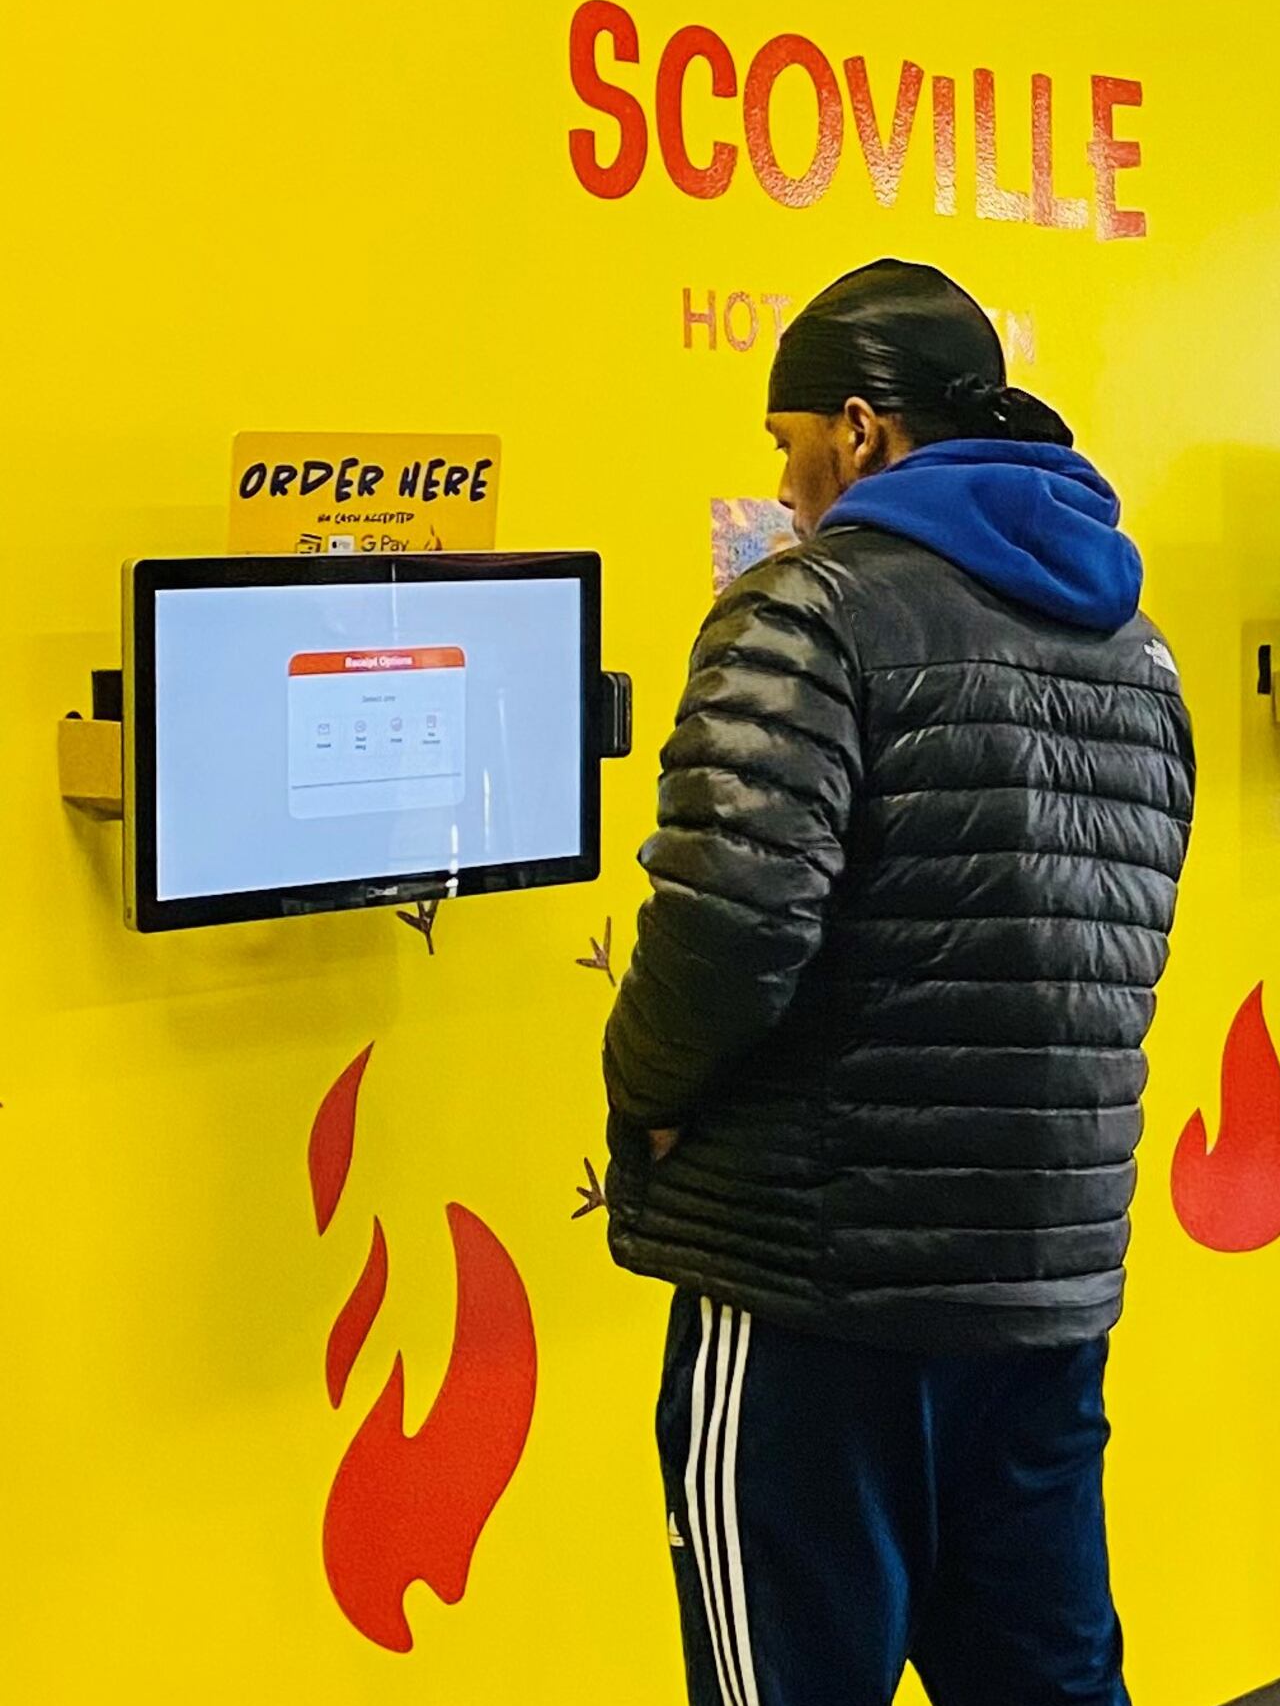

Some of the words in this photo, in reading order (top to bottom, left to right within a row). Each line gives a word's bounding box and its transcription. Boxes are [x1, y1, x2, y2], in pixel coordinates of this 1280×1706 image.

[682, 287, 794, 352] HOT
[239, 457, 384, 503] ORDER
[398, 458, 493, 502] HERE
